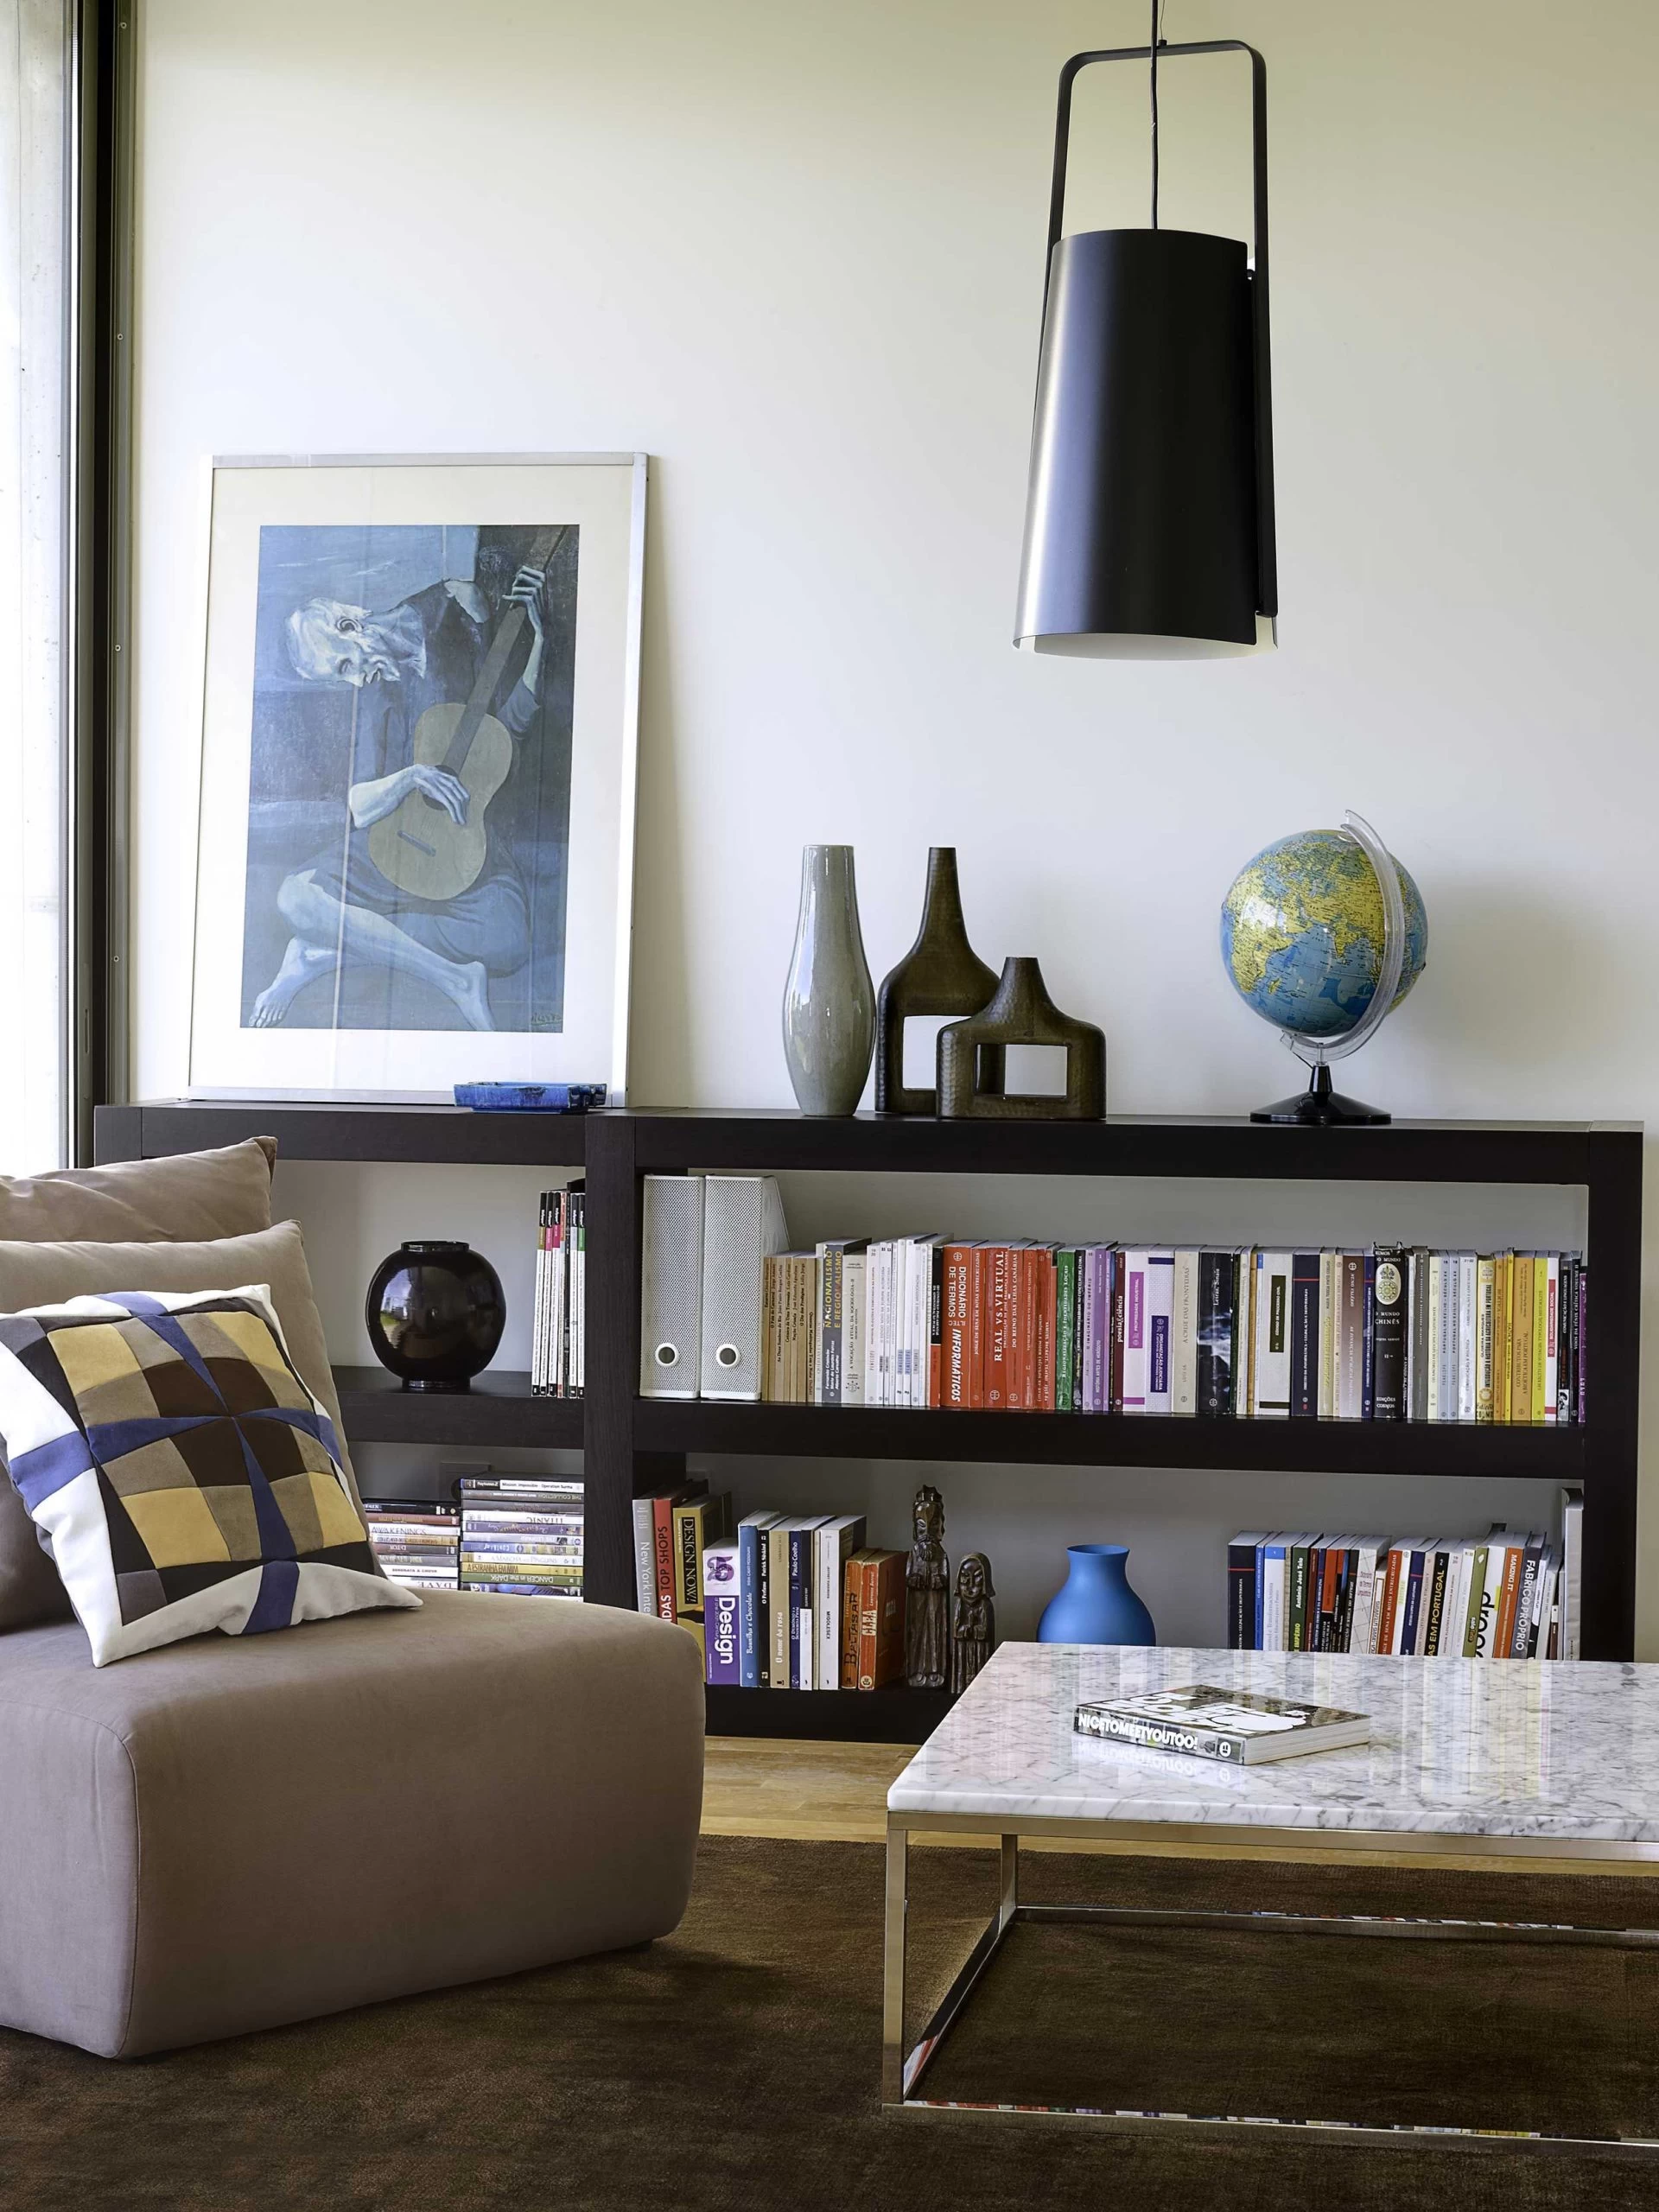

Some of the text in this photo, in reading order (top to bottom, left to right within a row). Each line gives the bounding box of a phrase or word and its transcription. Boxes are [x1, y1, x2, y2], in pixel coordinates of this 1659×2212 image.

[949, 1267, 956, 1278] DE
[958, 1267, 968, 1318] DICIONÁRIO
[995, 1251, 1004, 1306] VIRTUAL
[951, 1329, 963, 1402] INFORMÁTICOS
[1012, 1338, 1017, 1347] DO
[472, 1564, 497, 1573] ESTRANHA
[507, 1565, 518, 1573] MIM
[640, 1541, 652, 1615] New York Inte
[658, 1527, 670, 1590] TOP SHOPS
[683, 1518, 696, 1602] DESIGN NOW!
[1508, 1554, 1516, 1583] MAKING
[1522, 1560, 1535, 1605] FABRICO
[1431, 1570, 1444, 1624] PORTUGAL
[714, 1597, 736, 1664] Design
[862, 1610, 877, 1636] CLEA
[1429, 1626, 1438, 1642] EM
[1077, 1713, 1199, 1750] NICETOMEETYOUTOO!
